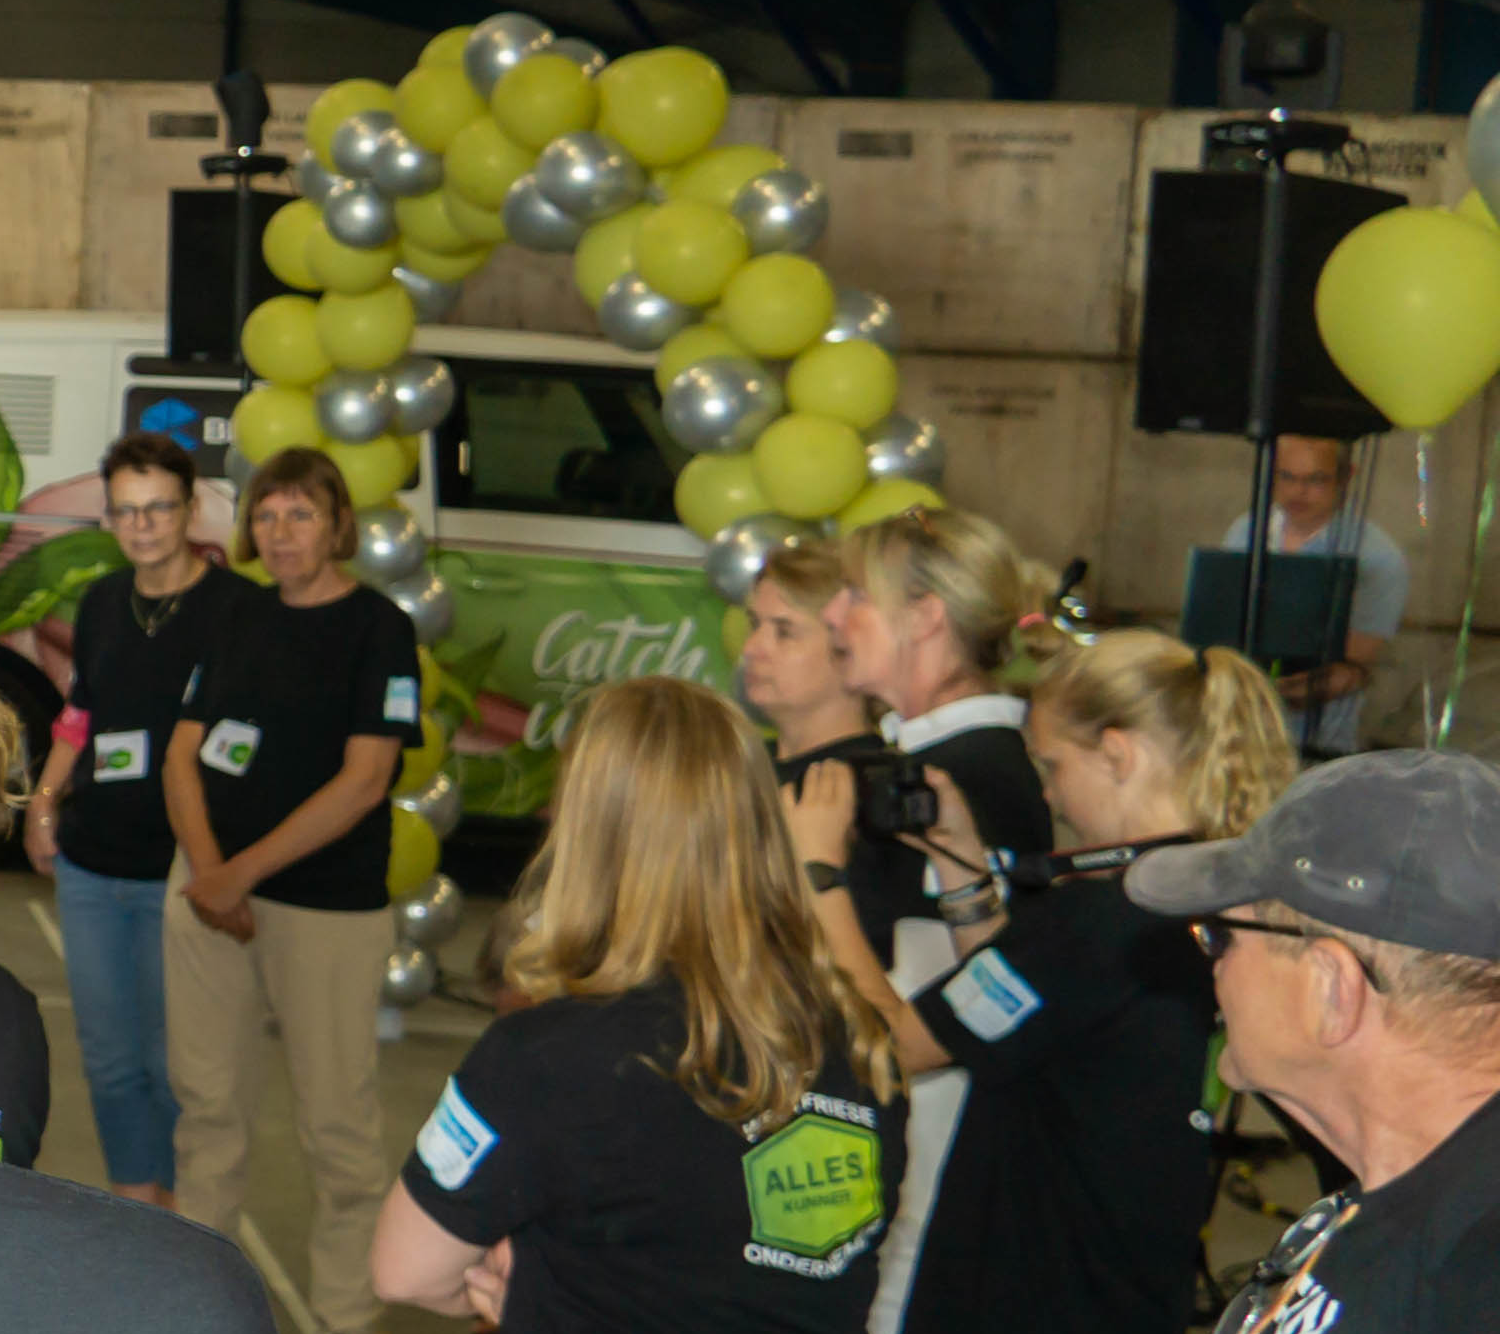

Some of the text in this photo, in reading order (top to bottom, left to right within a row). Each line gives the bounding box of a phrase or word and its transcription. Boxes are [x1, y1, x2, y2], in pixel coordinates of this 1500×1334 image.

[532, 610, 706, 683] Catch
[764, 1152, 864, 1193] ALLES
[782, 1188, 853, 1214] KUNNER
